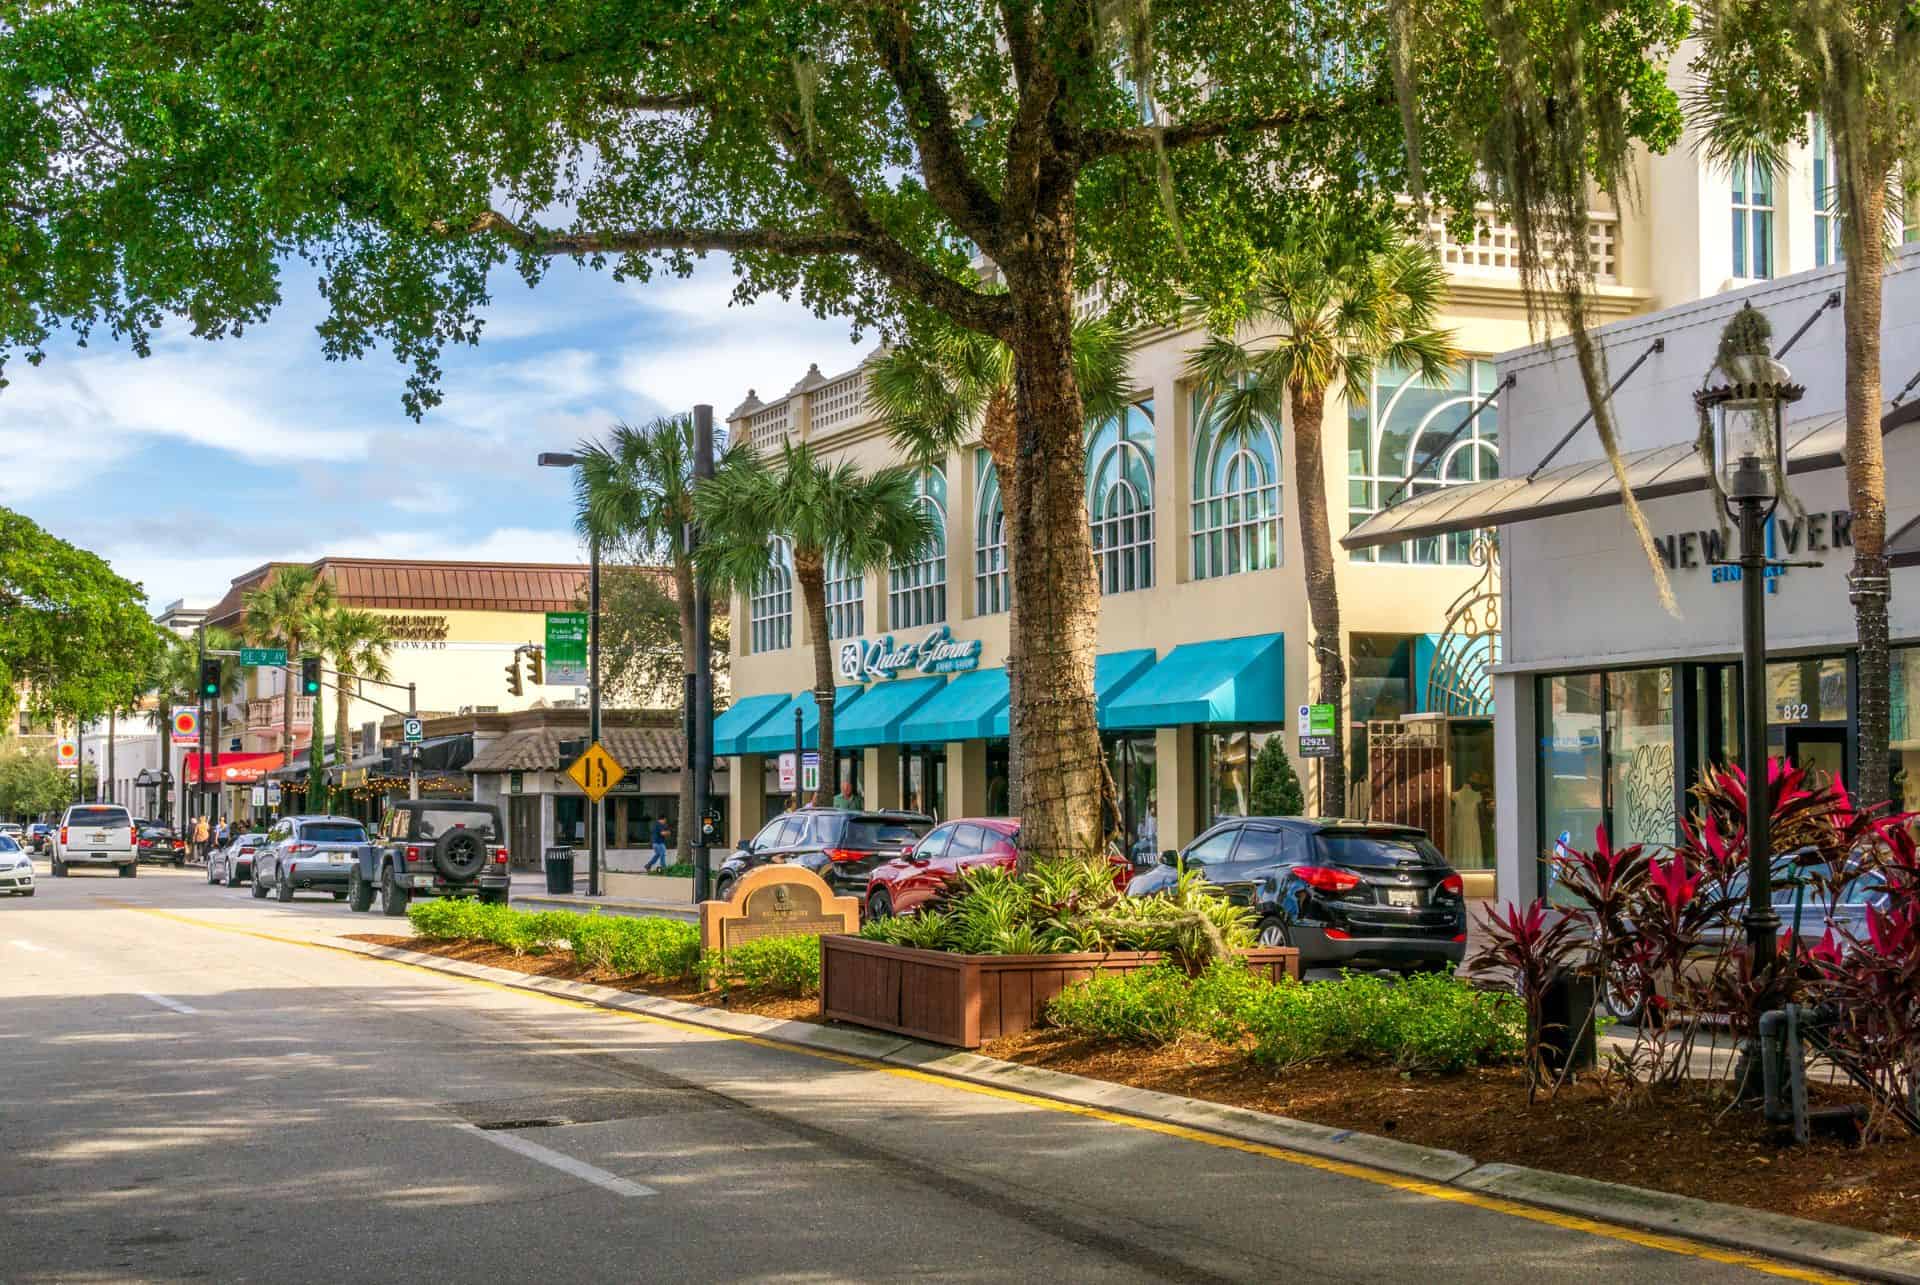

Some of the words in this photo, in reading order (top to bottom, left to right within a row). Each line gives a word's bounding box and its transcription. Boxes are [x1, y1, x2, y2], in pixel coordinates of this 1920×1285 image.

[1653, 529, 1727, 569] NEW
[864, 635, 917, 678] Quiet
[915, 626, 978, 672] Storm
[1783, 704, 1809, 720] 822
